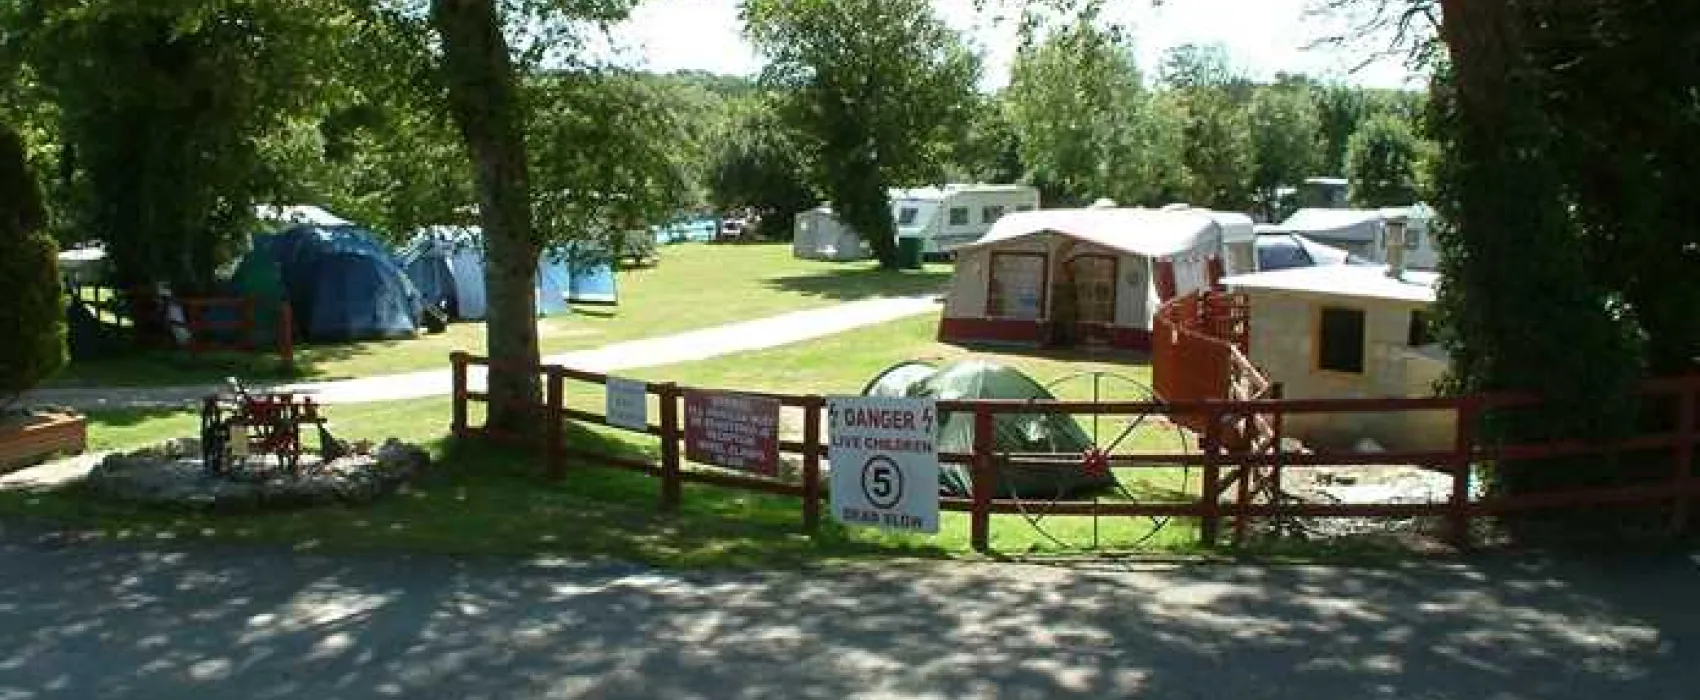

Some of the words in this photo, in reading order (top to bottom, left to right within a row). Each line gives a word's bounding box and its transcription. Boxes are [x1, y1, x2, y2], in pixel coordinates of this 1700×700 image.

[845, 408, 915, 429] DANGER
[833, 436, 861, 449] LIVE
[865, 437, 932, 453] CHILDREN
[873, 469, 892, 498] 5
